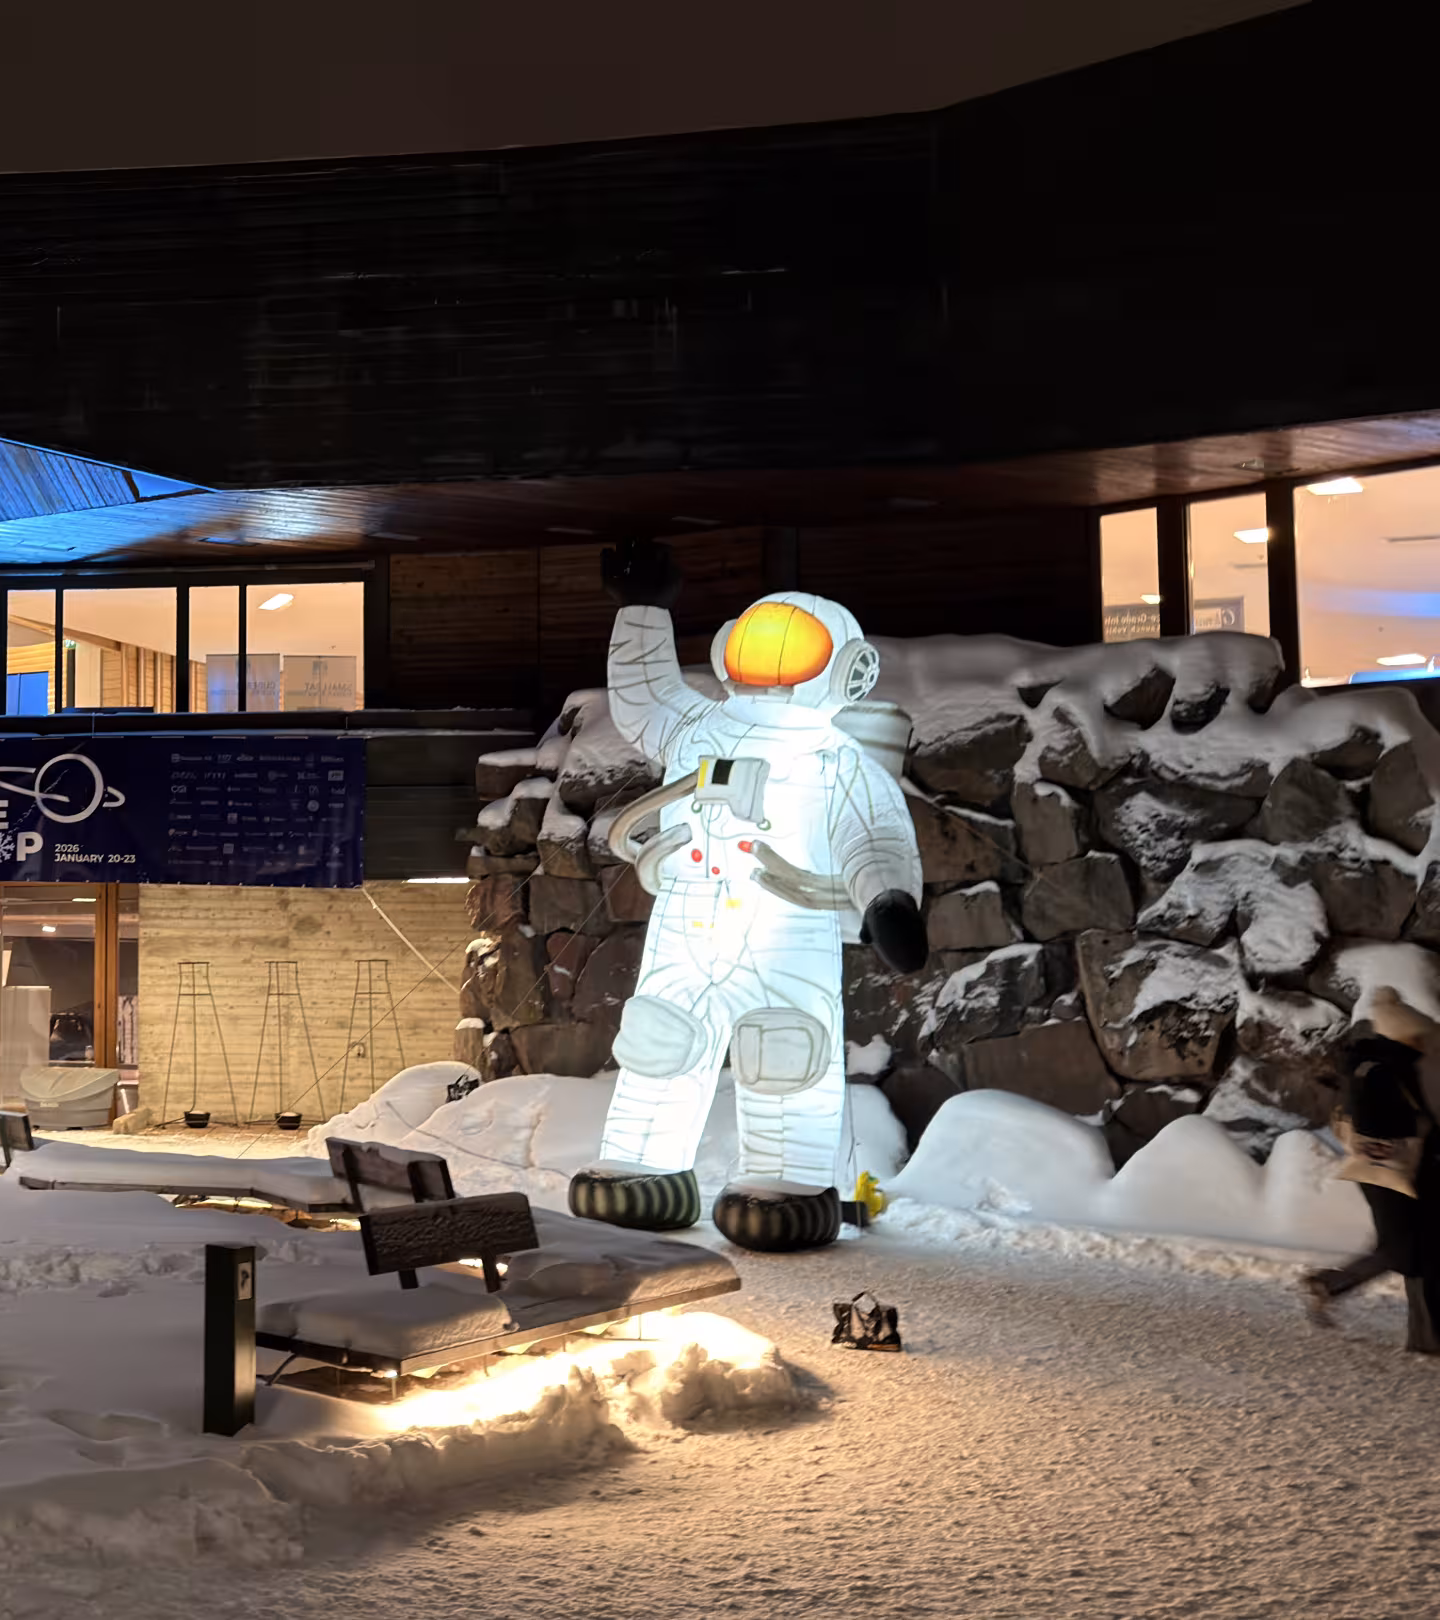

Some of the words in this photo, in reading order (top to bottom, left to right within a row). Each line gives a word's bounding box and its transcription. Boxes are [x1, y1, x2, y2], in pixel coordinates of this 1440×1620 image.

[54, 843, 80, 853] 2026
[54, 853, 105, 863] JANUARY
[107, 854, 136, 863] 20-23
